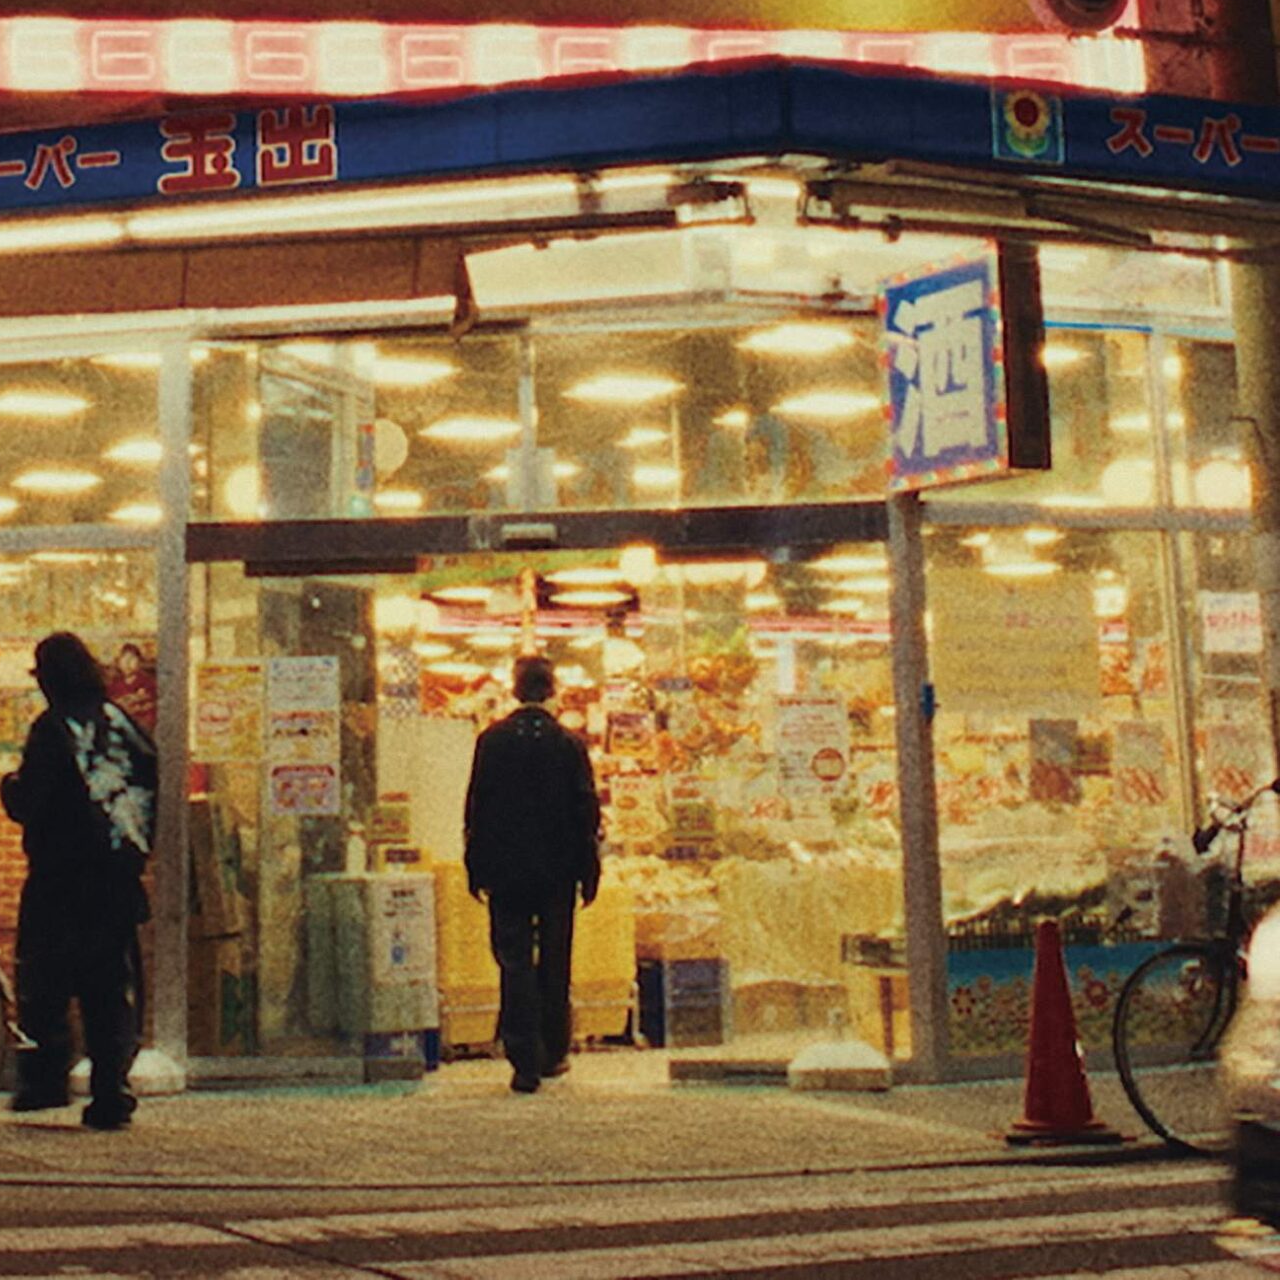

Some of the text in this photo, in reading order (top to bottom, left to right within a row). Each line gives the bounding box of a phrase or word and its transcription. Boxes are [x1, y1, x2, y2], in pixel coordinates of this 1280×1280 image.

[159, 105, 336, 193] 玉出
[1107, 108, 1280, 165] スーパー
[892, 279, 987, 461] 酒
